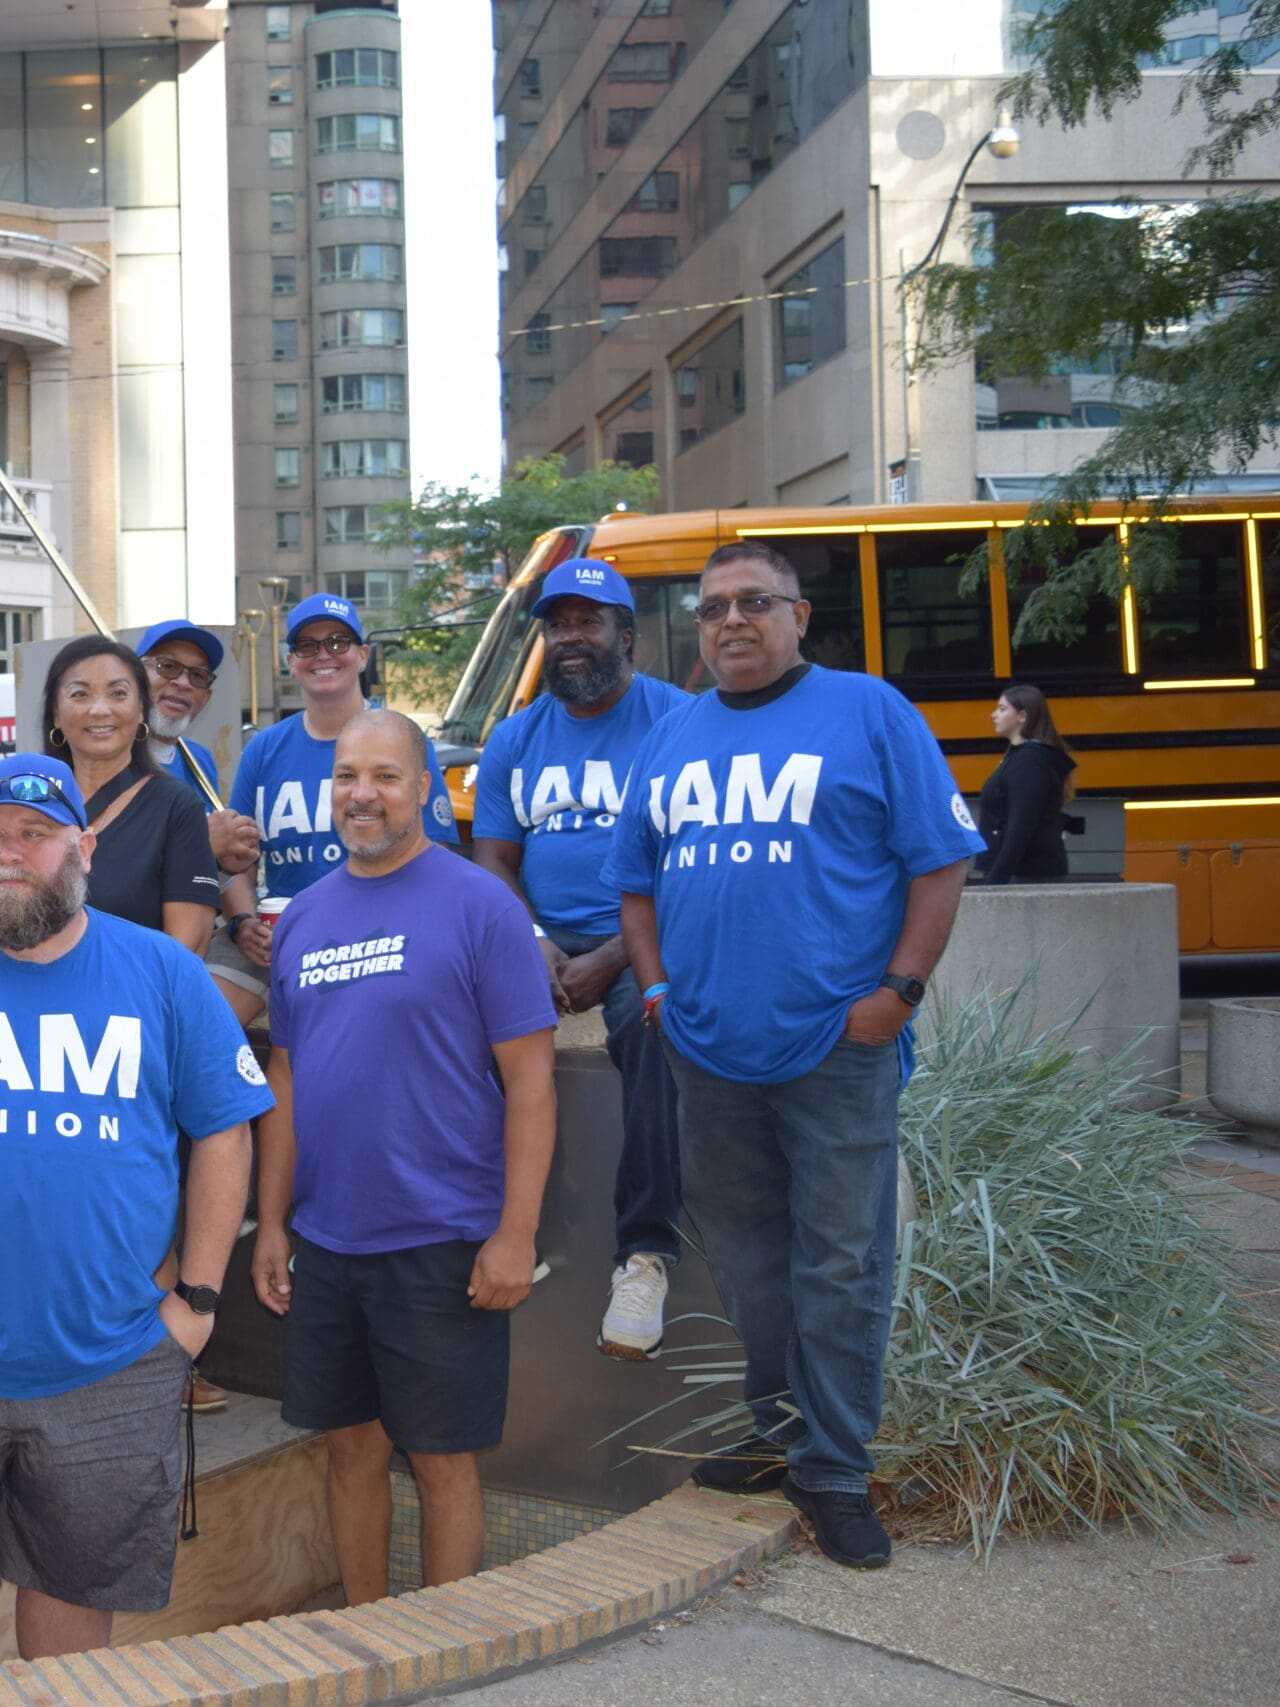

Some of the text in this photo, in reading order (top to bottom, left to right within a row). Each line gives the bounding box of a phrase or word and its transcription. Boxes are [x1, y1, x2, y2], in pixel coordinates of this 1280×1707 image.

[576, 568, 605, 581] IAM
[649, 752, 823, 838] IAM
[532, 812, 616, 834] NIO
[271, 843, 342, 865] UNIO
[302, 934, 406, 970] WORKERS
[299, 953, 405, 989] TOGETHER
